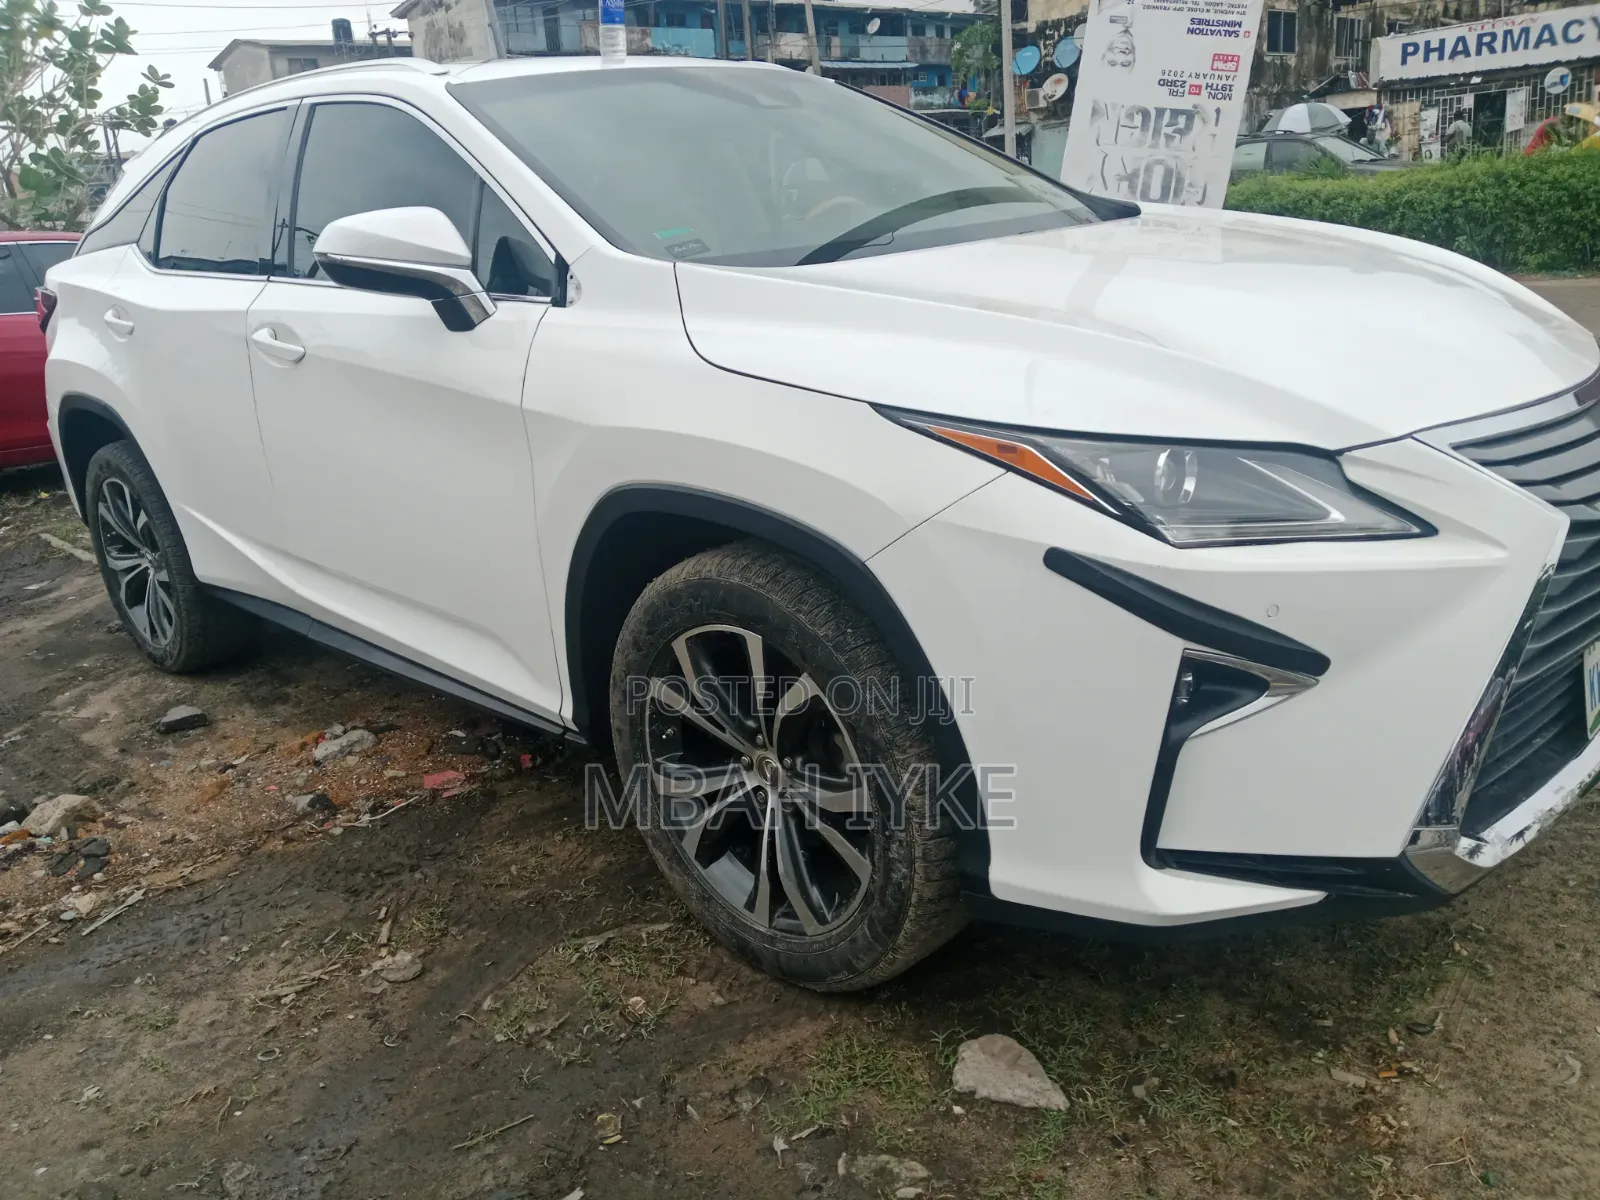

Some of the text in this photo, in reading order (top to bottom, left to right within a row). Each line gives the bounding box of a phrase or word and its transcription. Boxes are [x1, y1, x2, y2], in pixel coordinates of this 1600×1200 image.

[1190, 17, 1243, 28] MINISTRIES
[1186, 26, 1240, 38] SALVATION
[1161, 69, 1237, 82] JANUARY 2026
[1157, 78, 1187, 89] 23RD
[1205, 82, 1234, 92] 19TH
[1168, 87, 1186, 98] FRI.
[1207, 91, 1233, 101] MON.
